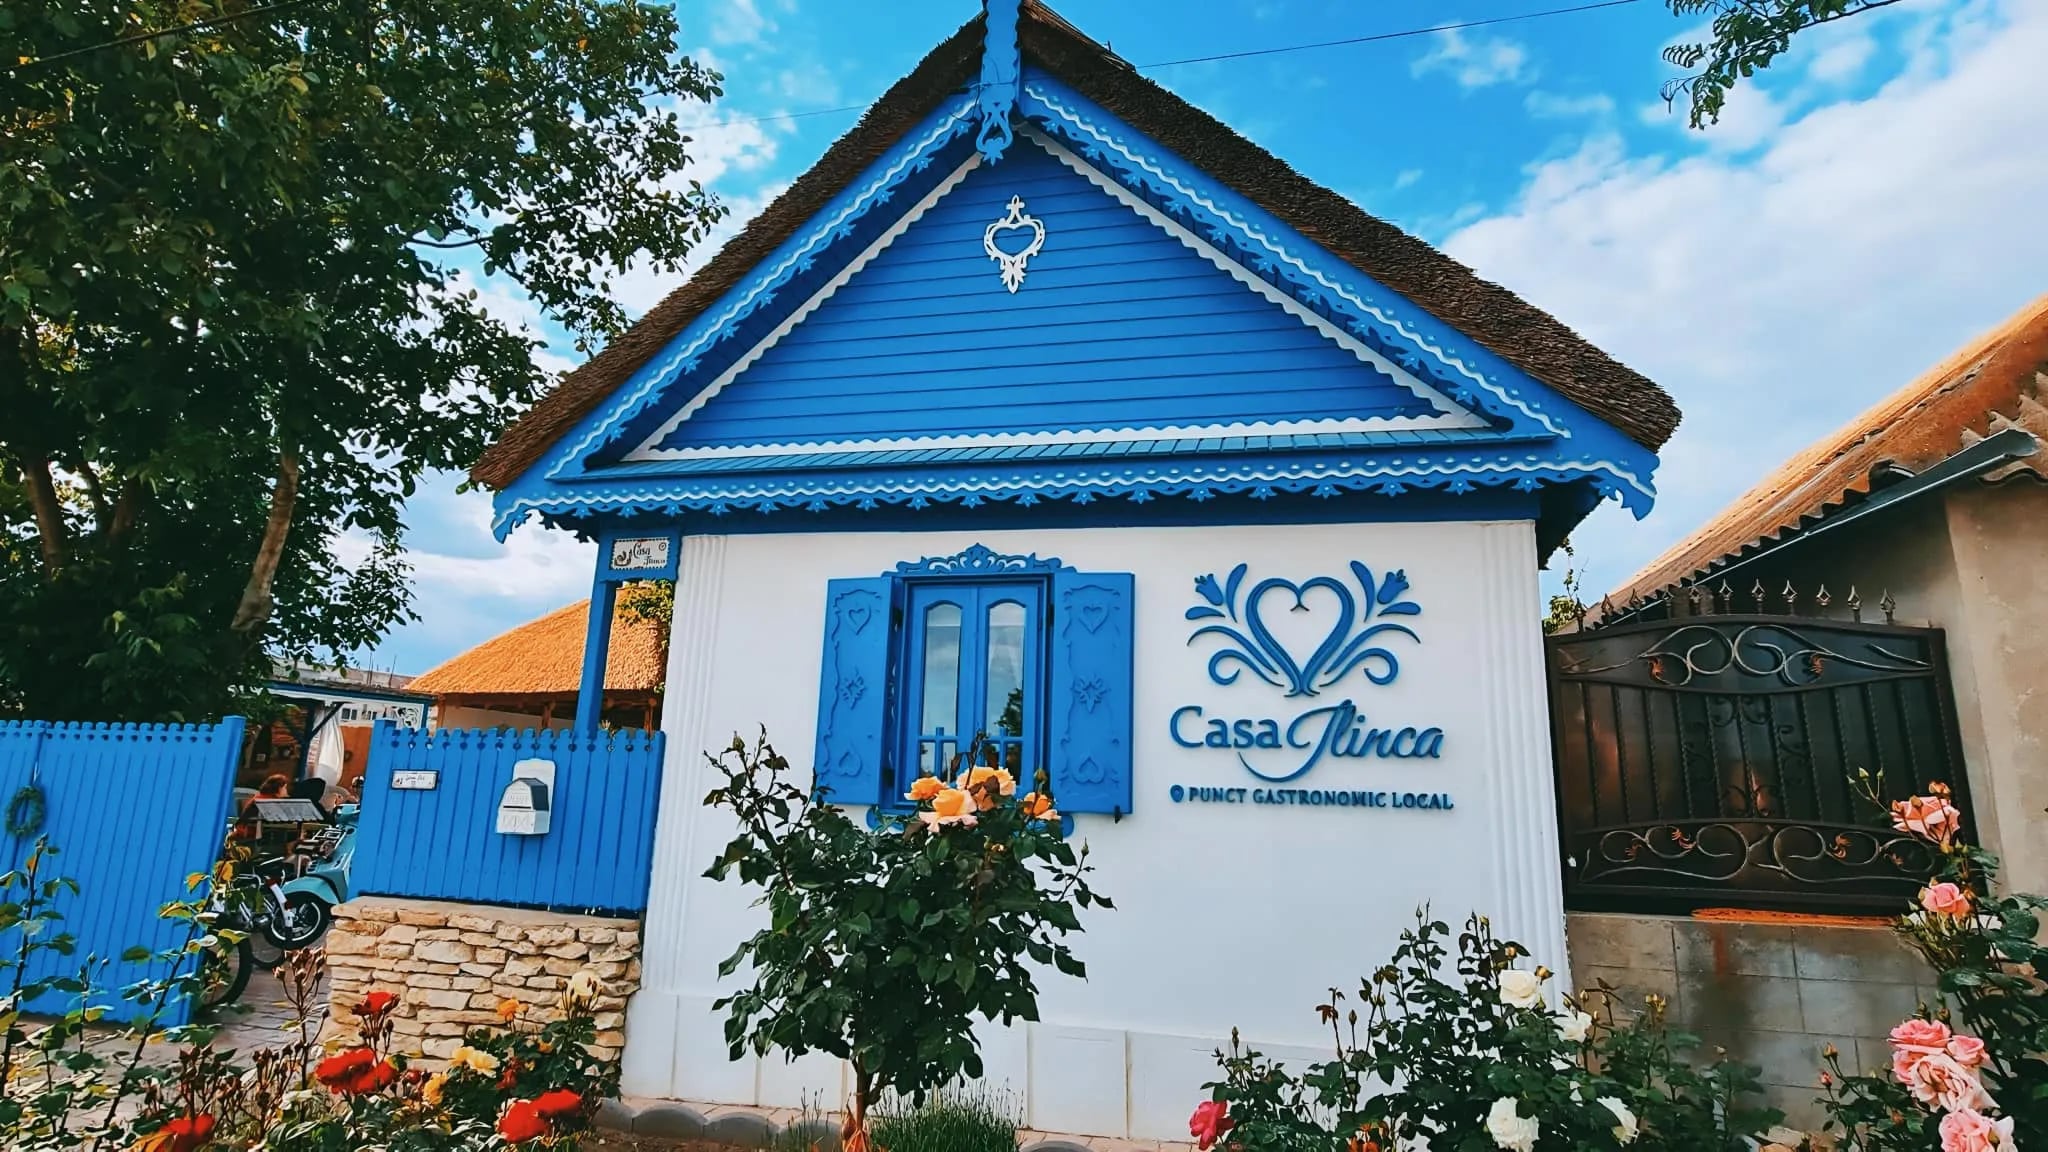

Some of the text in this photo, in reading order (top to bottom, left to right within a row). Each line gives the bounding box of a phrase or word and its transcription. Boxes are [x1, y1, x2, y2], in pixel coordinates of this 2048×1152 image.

[1169, 705, 1282, 749] Casa
[1188, 786, 1454, 810] PUNCT GASTRONOMIC LOCAL
